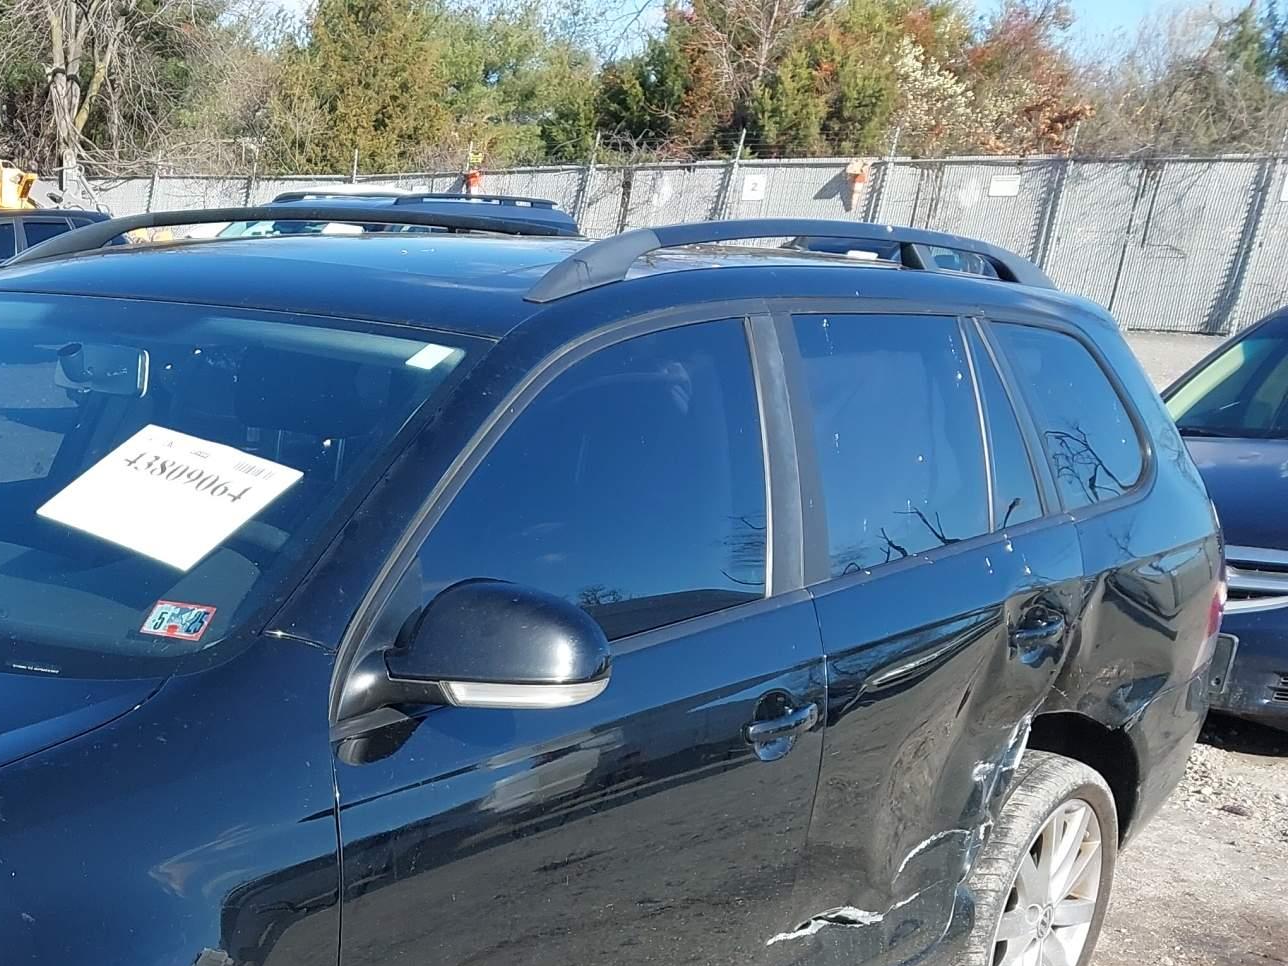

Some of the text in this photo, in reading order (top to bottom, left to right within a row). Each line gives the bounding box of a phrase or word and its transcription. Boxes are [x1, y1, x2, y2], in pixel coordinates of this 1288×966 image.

[750, 182, 758, 191] 2
[124, 452, 253, 502] 43809064
[153, 611, 168, 630] 5
